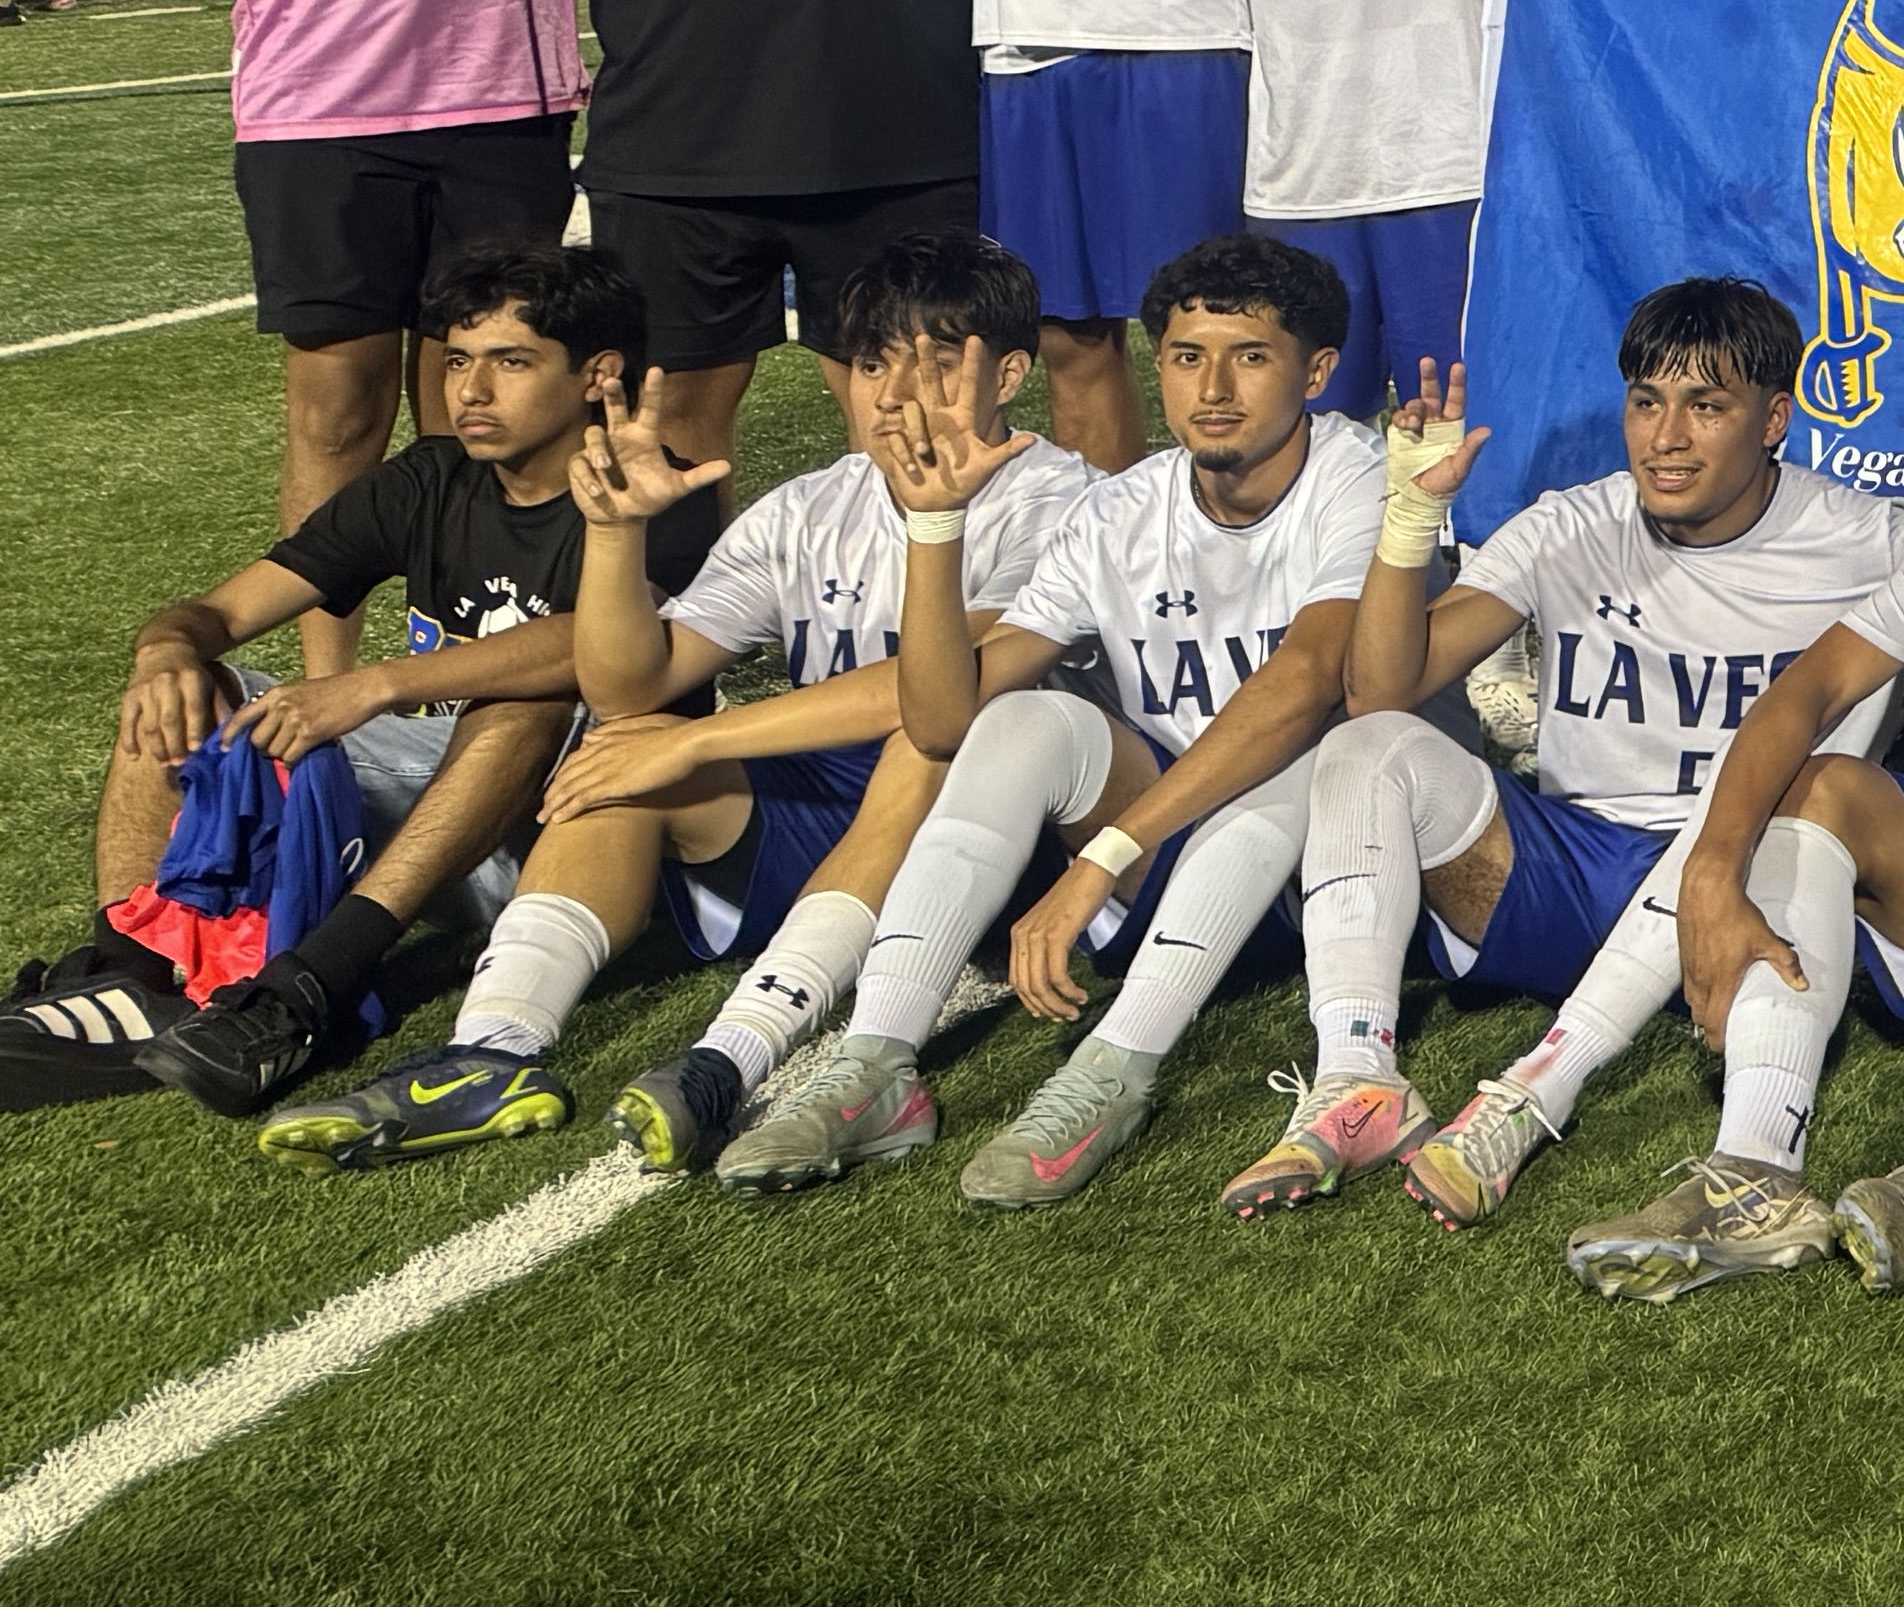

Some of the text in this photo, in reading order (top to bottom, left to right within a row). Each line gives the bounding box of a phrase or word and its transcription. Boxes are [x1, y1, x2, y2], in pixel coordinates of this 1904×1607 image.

[1132, 638, 1217, 716] LA
[1554, 632, 1809, 730] LA VE
